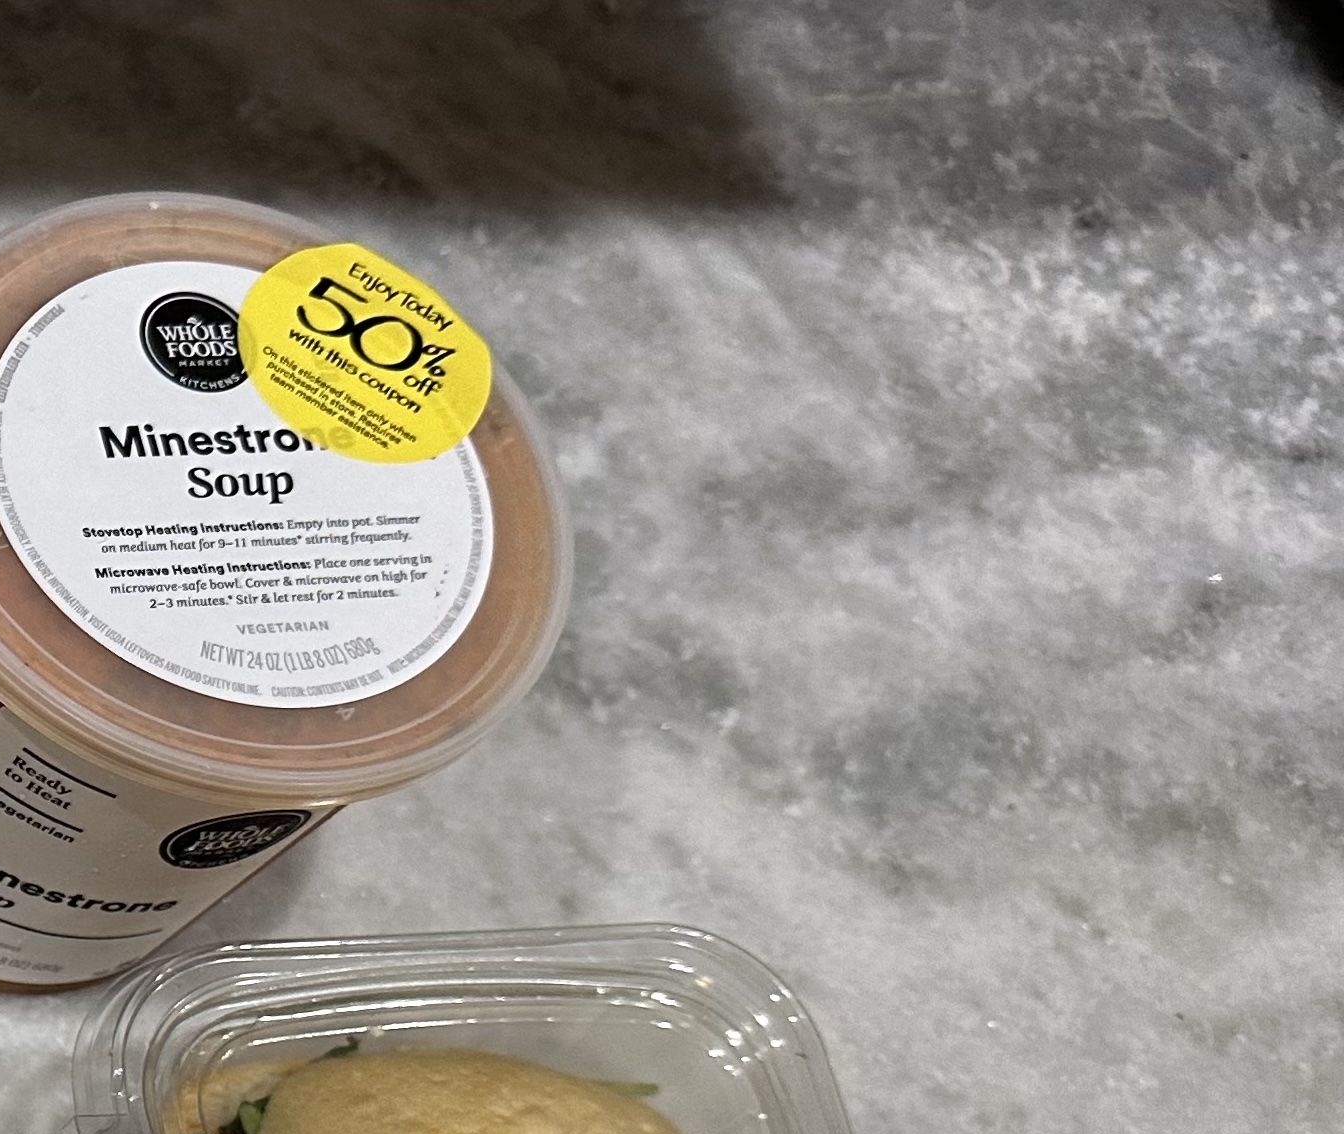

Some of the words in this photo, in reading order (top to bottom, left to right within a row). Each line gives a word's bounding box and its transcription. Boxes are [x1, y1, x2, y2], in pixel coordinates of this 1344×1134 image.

[348, 262, 399, 302] Enjoy
[401, 291, 453, 332] Today
[156, 324, 235, 341] WHOLE
[166, 341, 237, 358] FOODS
[296, 277, 456, 378] 50%
[403, 375, 444, 397] off
[179, 359, 230, 367] MARKET
[180, 373, 239, 390] KITCHENS
[289, 329, 324, 357] with
[324, 346, 358, 375] this
[359, 372, 422, 414] coupon
[187, 467, 294, 505] Soup
[82, 527, 143, 538] Stovetop
[145, 524, 198, 536] Heating
[200, 520, 283, 533] Instructions:
[287, 520, 323, 531] Empty
[326, 518, 349, 528] into
[352, 517, 373, 528] pot.
[376, 516, 420, 526] Simmer
[4, 768, 23, 783] to
[26, 781, 72, 810] Heat
[12, 755, 72, 795] Ready
